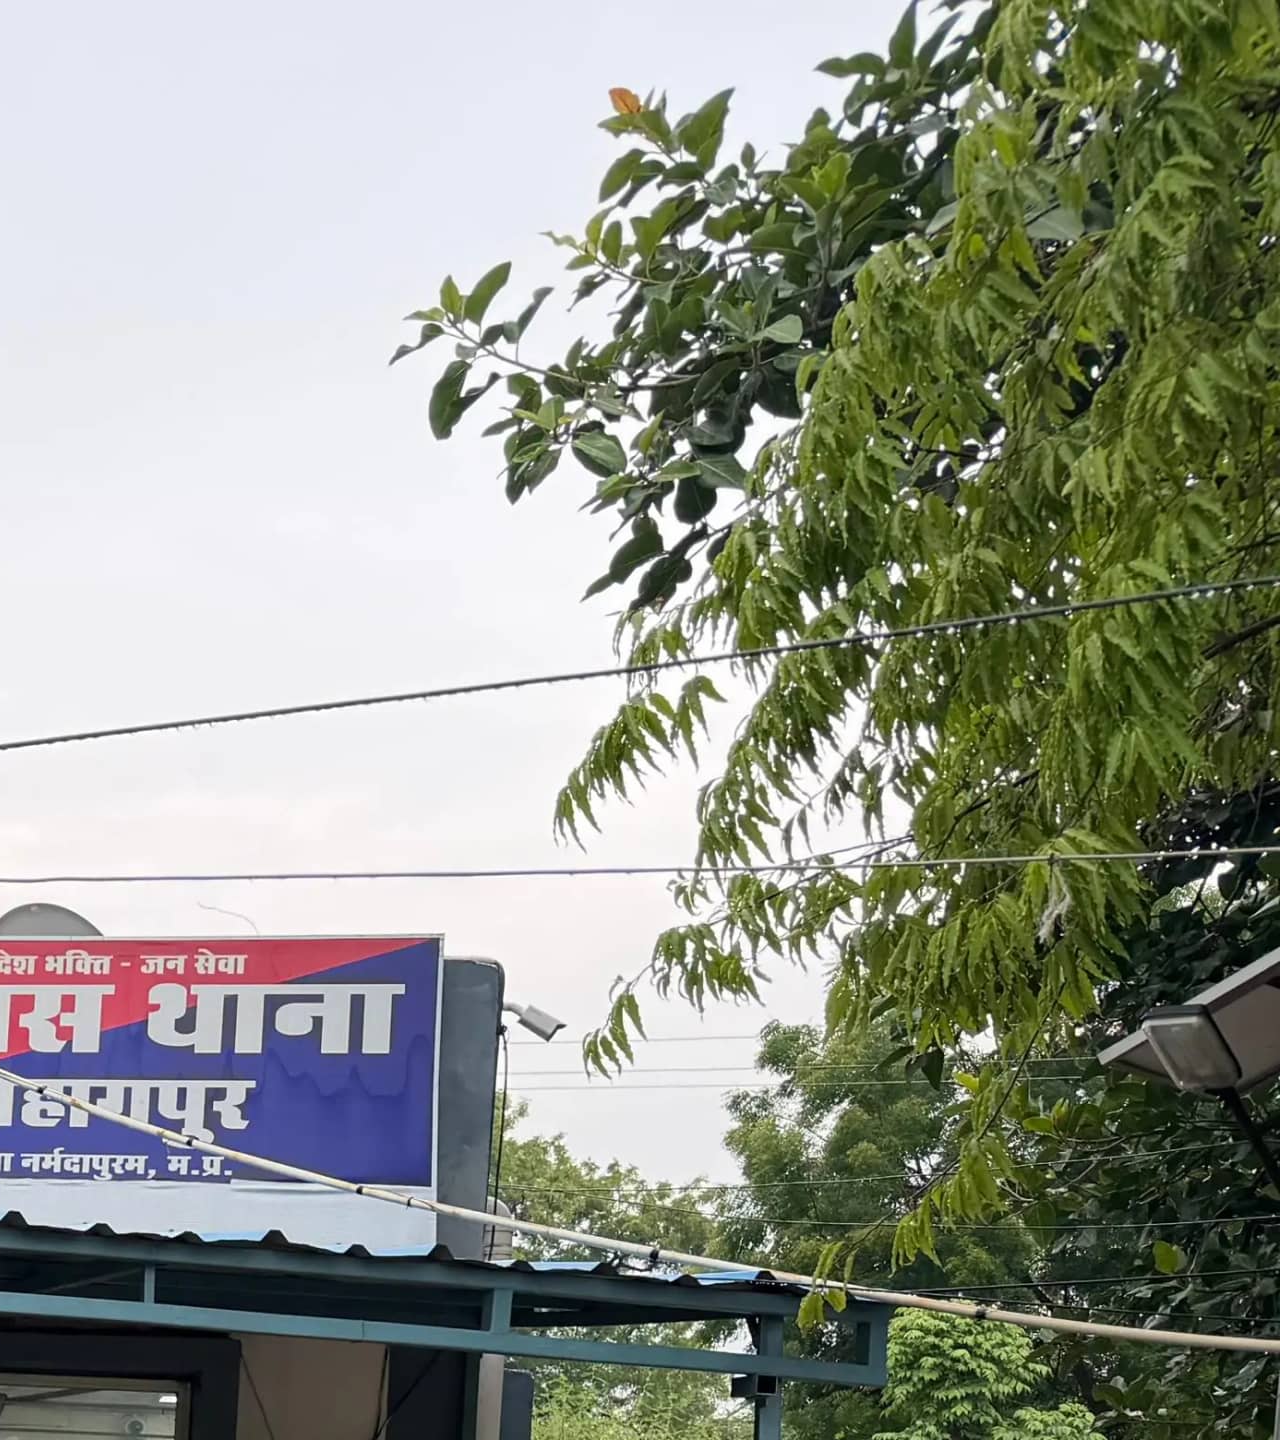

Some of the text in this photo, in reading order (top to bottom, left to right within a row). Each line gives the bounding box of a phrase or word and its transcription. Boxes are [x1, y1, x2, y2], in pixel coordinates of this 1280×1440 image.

[45, 948, 113, 976] भक्ति
[140, 954, 188, 976] जन
[194, 947, 248, 976] सेवा
[147, 982, 406, 1055] थाना
